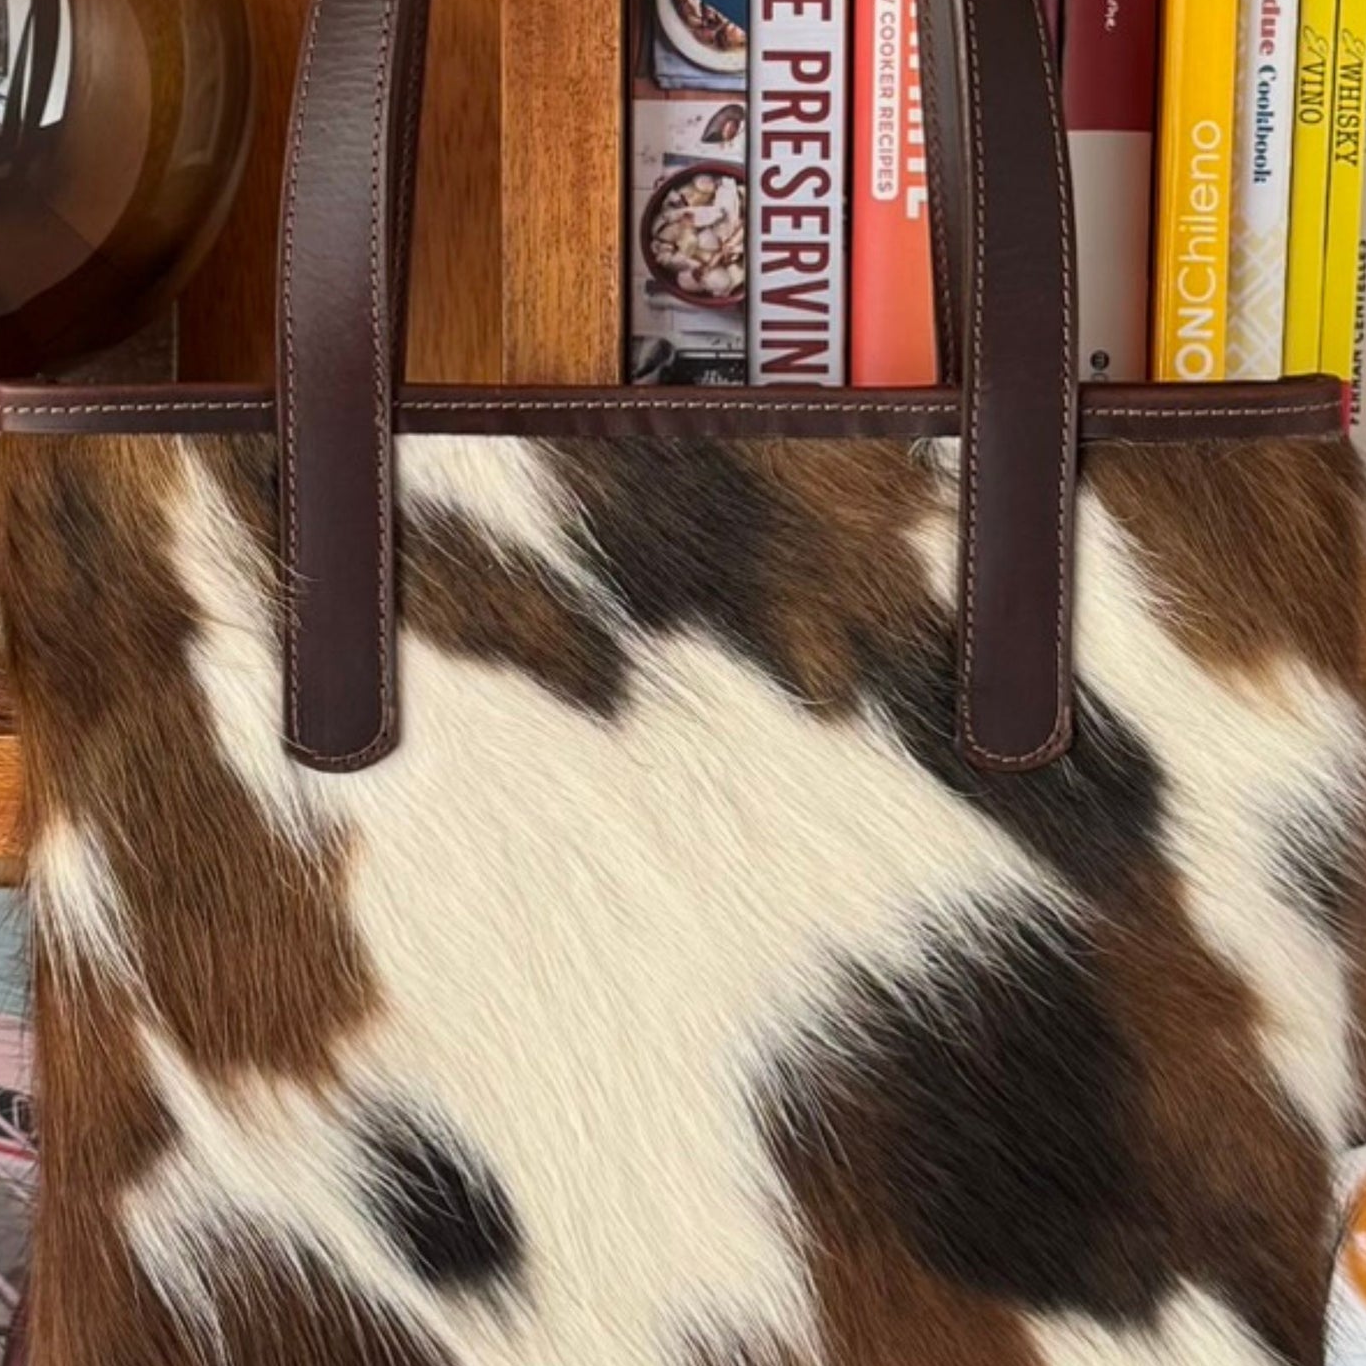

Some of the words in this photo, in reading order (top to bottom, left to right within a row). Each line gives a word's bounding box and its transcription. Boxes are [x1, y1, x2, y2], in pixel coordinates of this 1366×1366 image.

[878, 9, 897, 101] COOKER
[1300, 60, 1327, 126] VINO
[875, 105, 896, 196] RECIPES
[1253, 63, 1278, 185] Cookbook
[1335, 60, 1366, 168] WHISKY
[759, 49, 832, 389] PRESERVIN
